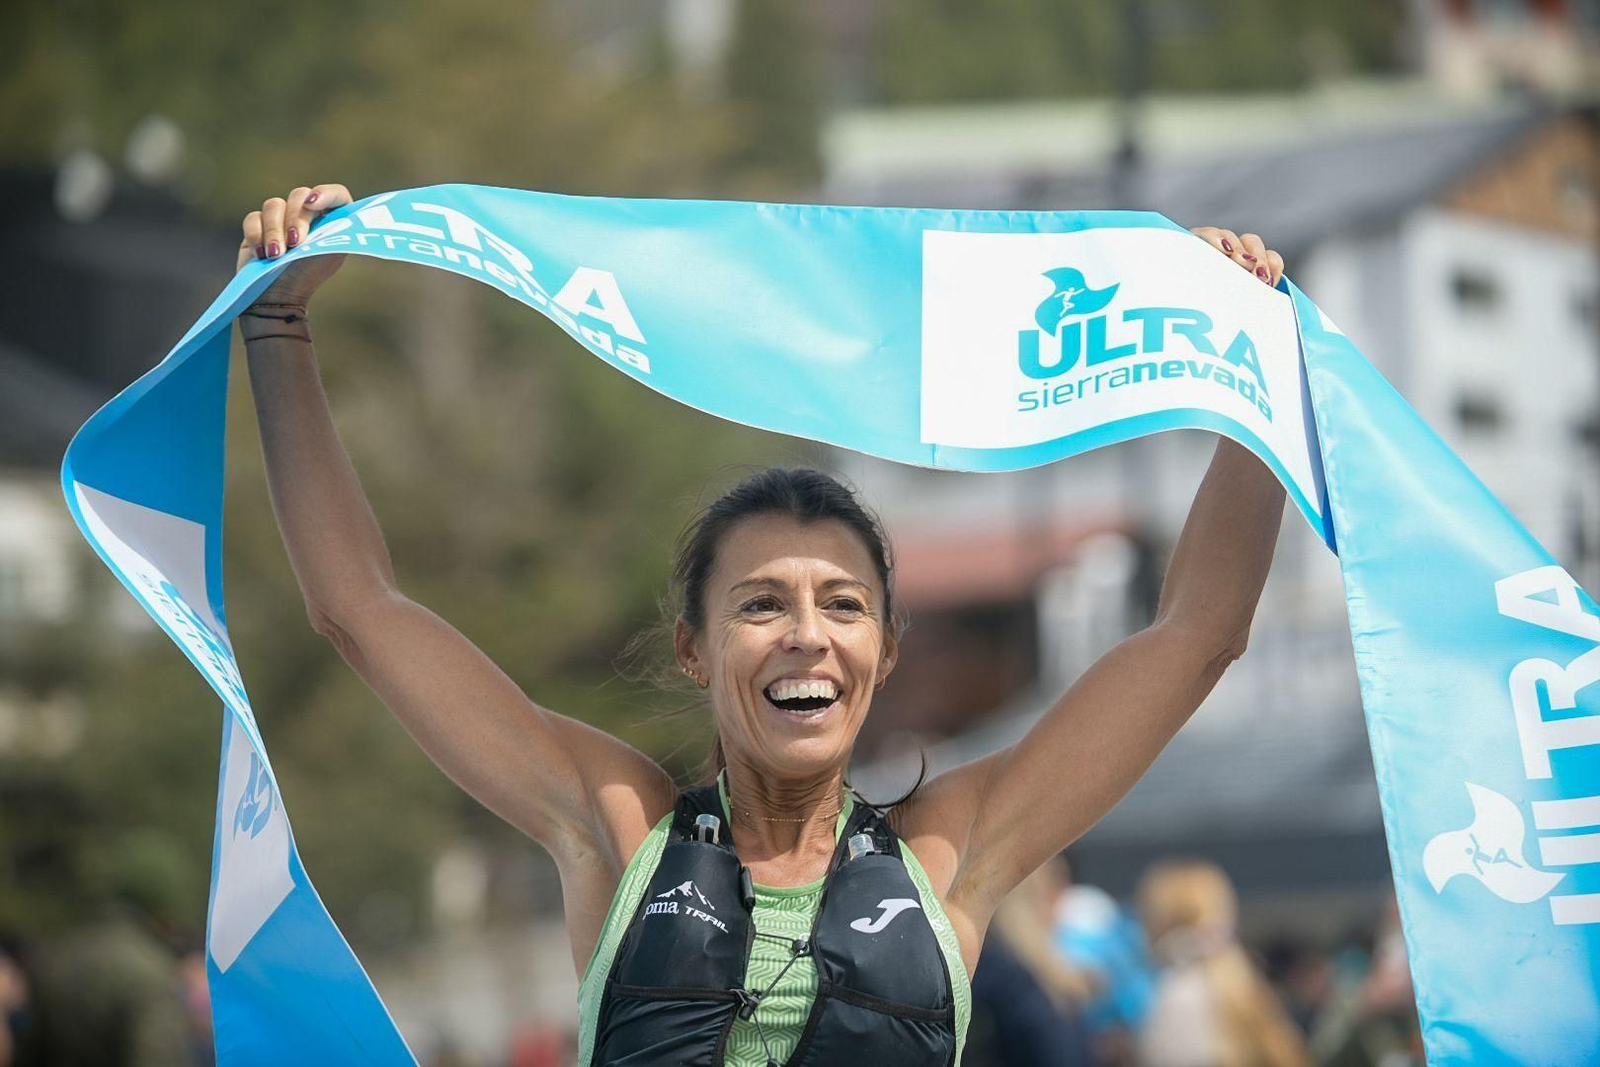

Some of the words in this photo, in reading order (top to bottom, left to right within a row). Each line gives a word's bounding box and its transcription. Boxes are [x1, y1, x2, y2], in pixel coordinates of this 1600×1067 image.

[301, 231, 651, 375] erranevada
[1017, 359, 1273, 424] sierranevada
[1018, 306, 1270, 400] ULTRA
[642, 901, 680, 921] oma
[685, 905, 729, 934] TRAIL
